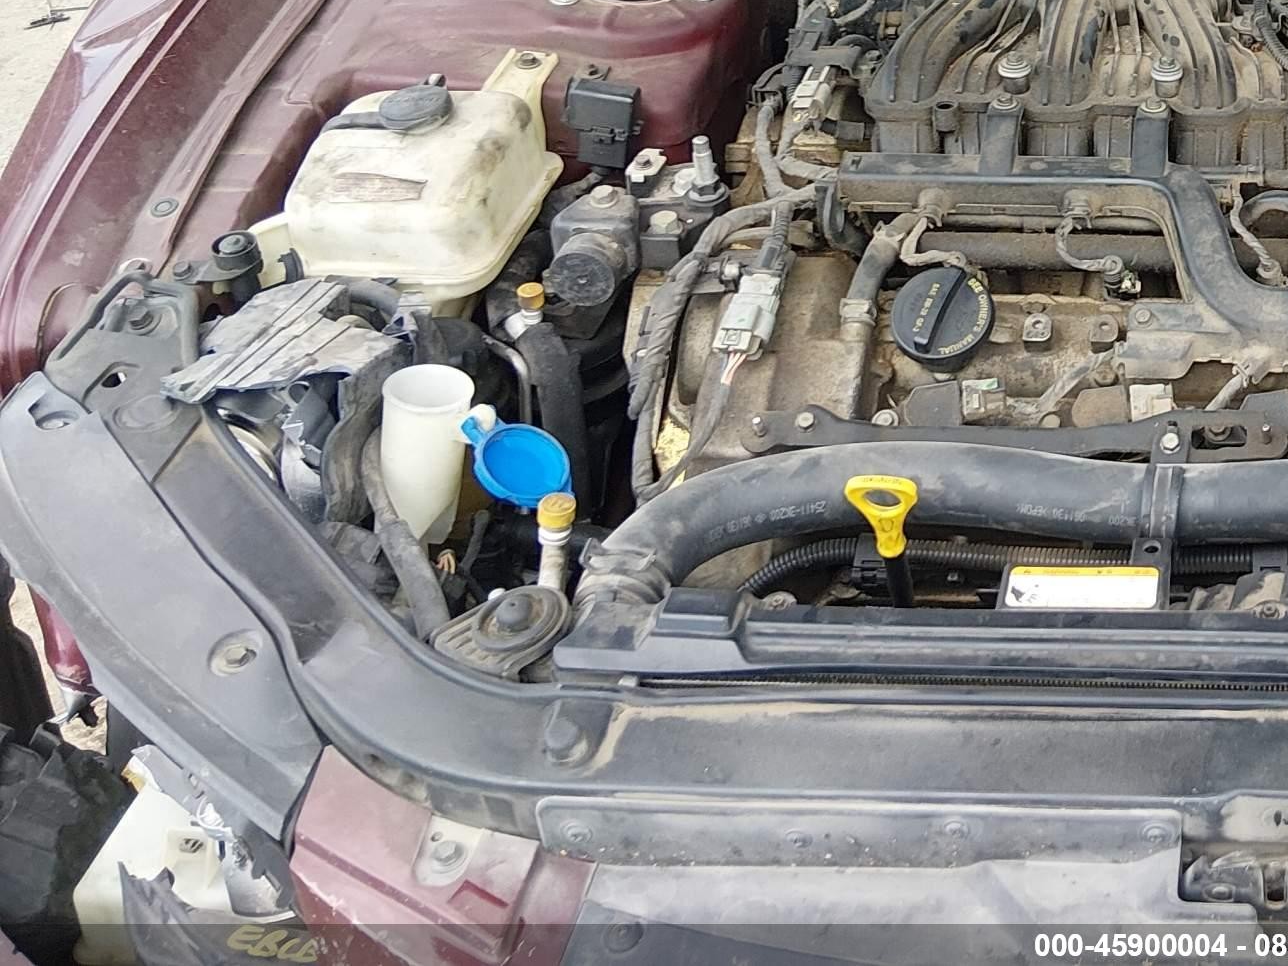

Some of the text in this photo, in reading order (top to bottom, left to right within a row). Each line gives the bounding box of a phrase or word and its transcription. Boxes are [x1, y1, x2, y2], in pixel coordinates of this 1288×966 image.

[938, 278, 989, 355] SEE OWNER'S MANUAL
